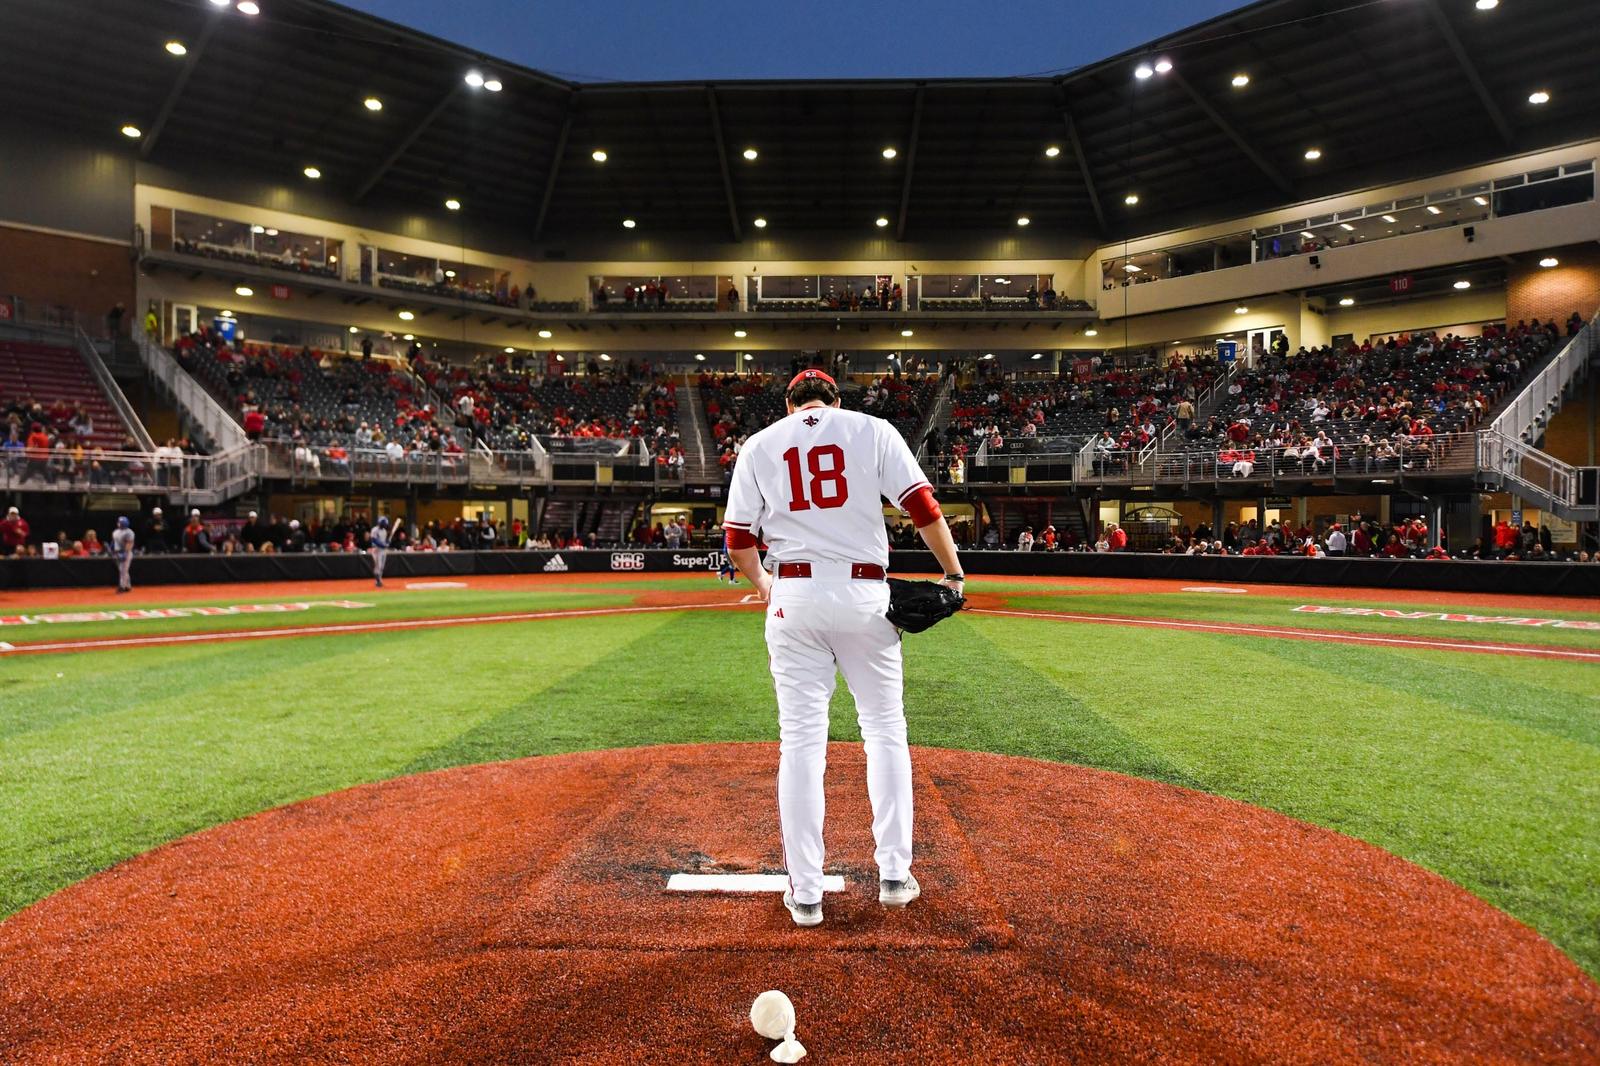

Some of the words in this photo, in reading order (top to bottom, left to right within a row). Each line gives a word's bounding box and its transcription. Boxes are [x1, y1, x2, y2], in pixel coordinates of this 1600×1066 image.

[1394, 278, 1408, 291] 110
[783, 444, 848, 512] 18
[611, 552, 644, 570] SBC
